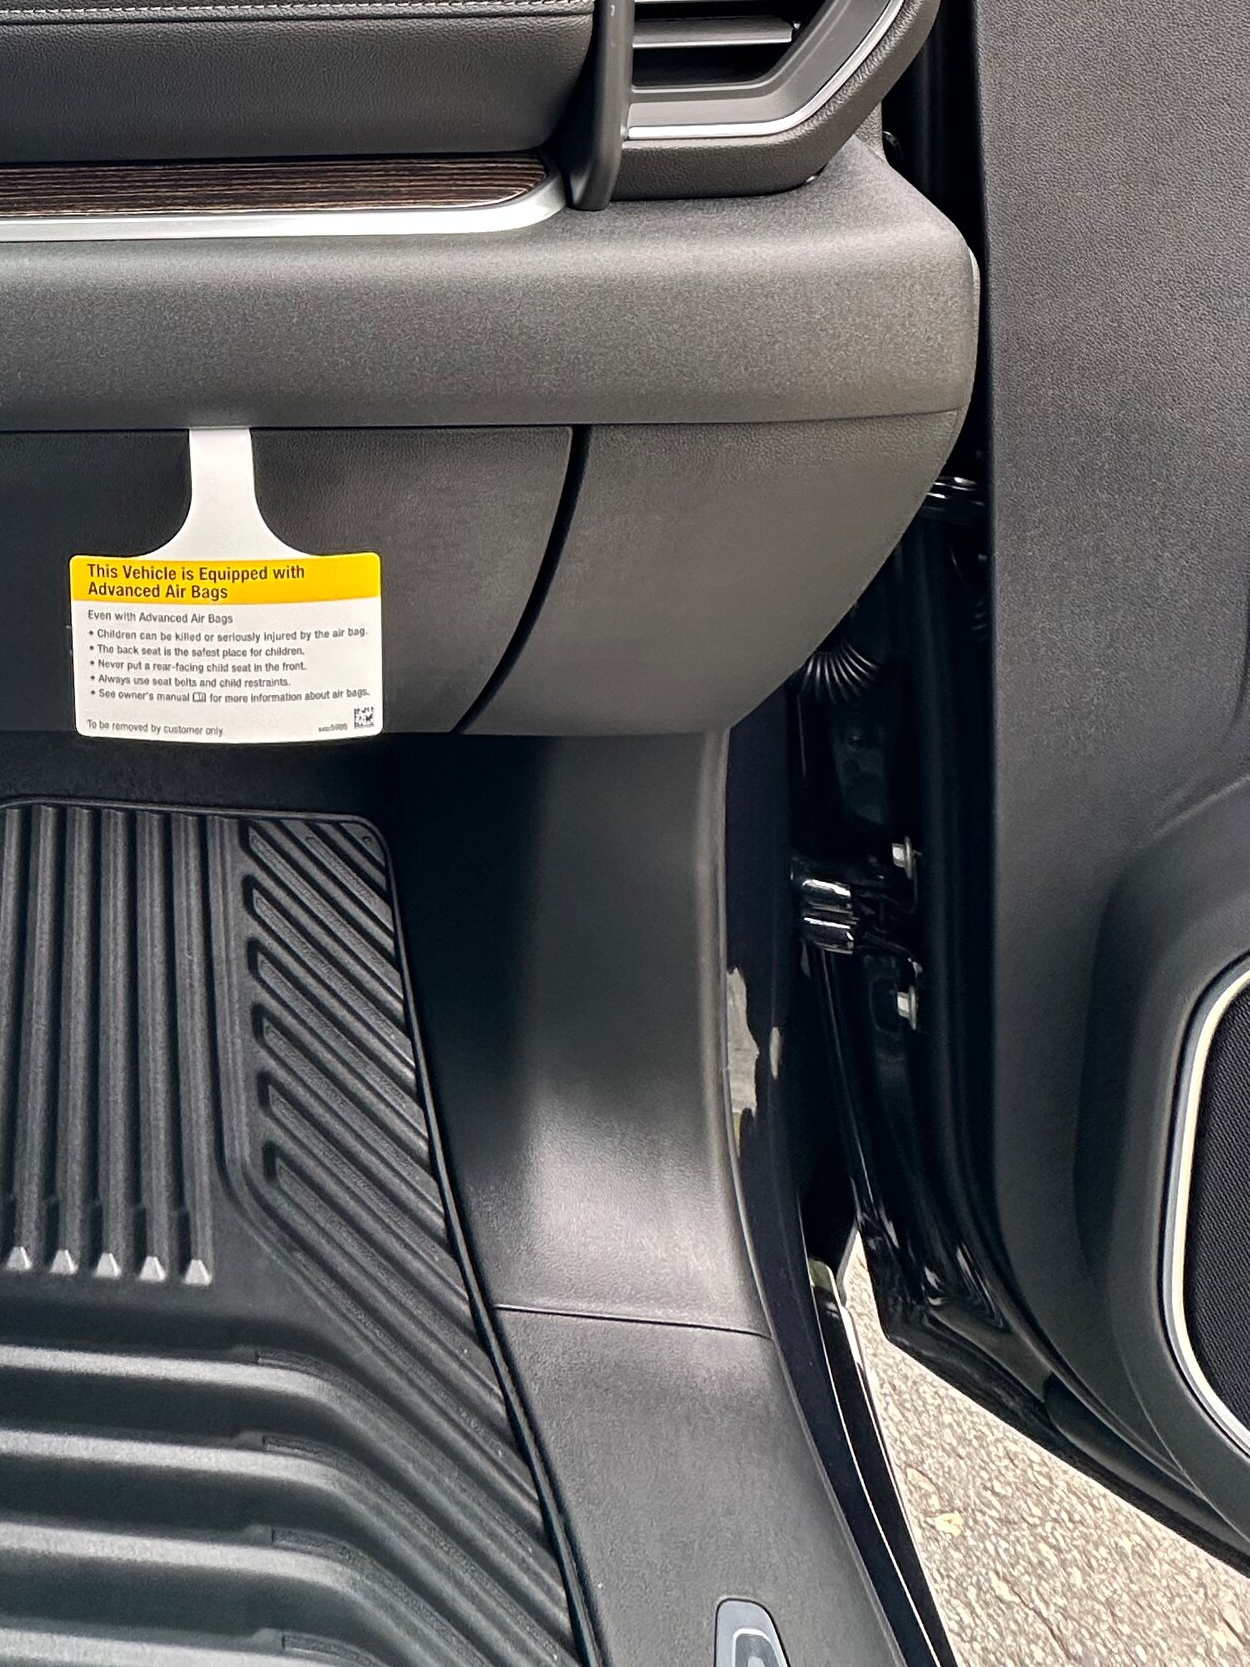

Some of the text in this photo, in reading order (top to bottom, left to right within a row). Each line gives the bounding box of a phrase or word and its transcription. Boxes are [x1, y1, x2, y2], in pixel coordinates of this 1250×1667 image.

[87, 563, 305, 584] This Vehicle is Equipped with
[88, 581, 228, 602] Advanced Air Bags
[87, 609, 233, 626] Even with Advanced Air Bags
[97, 627, 368, 643] Children can be killed or seriously injured by the air bag.
[97, 644, 305, 659] The back seat is the safest place for children.
[98, 659, 124, 669] Never
[127, 661, 142, 671] put
[153, 662, 204, 674] rear-facing
[206, 663, 228, 672] child
[231, 663, 251, 672] seat
[254, 663, 262, 672] in
[265, 662, 279, 672] the
[282, 661, 307, 671] front.
[98, 674, 131, 685] Always
[152, 677, 172, 686] seat
[174, 677, 197, 687] belts
[199, 678, 217, 687] and
[219, 678, 241, 688] child
[244, 678, 291, 688] restraints.
[99, 688, 370, 703] See owner's manual for more information about air bags.
[87, 718, 223, 737] To be removed by customer only
